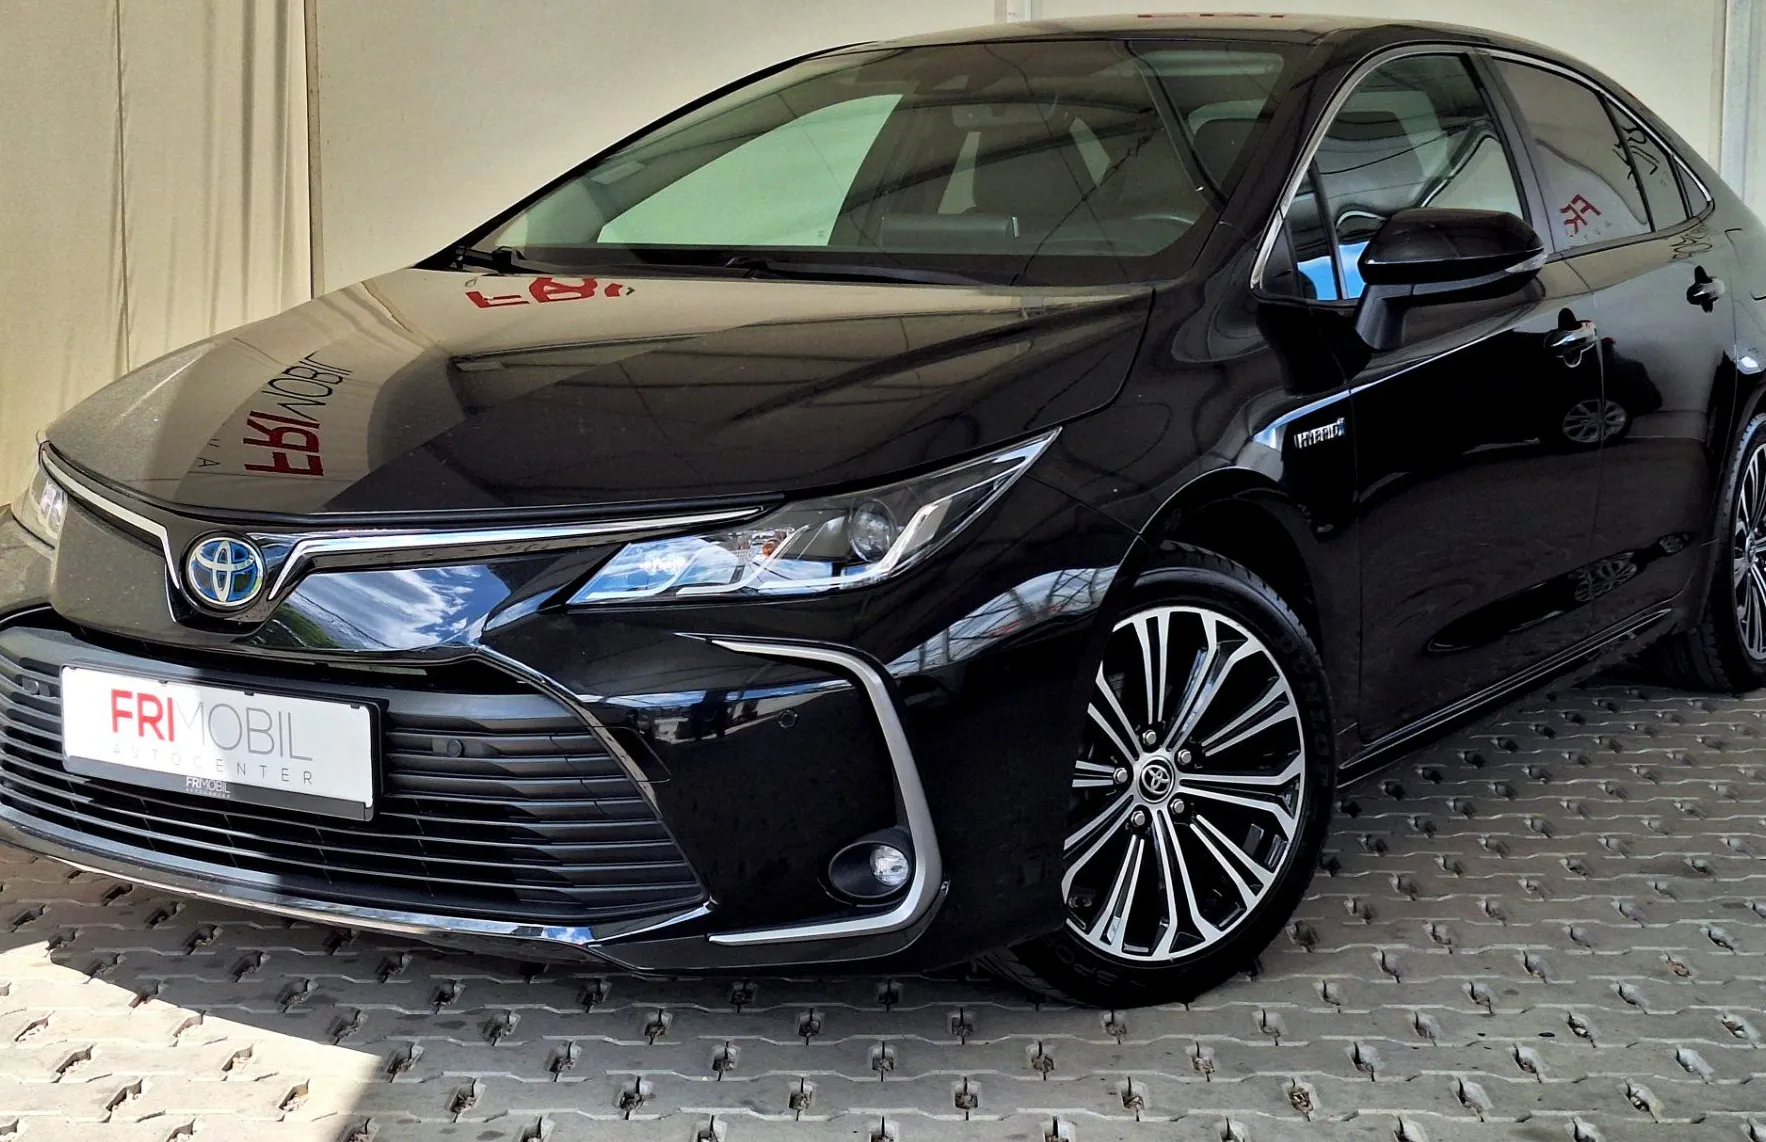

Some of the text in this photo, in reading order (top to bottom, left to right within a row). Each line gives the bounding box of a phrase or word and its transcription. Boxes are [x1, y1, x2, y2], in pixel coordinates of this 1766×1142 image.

[111, 688, 313, 762] FRIMOBIL
[113, 743, 312, 785] AUTOCENTER
[186, 776, 231, 794] FRIMOBIL
